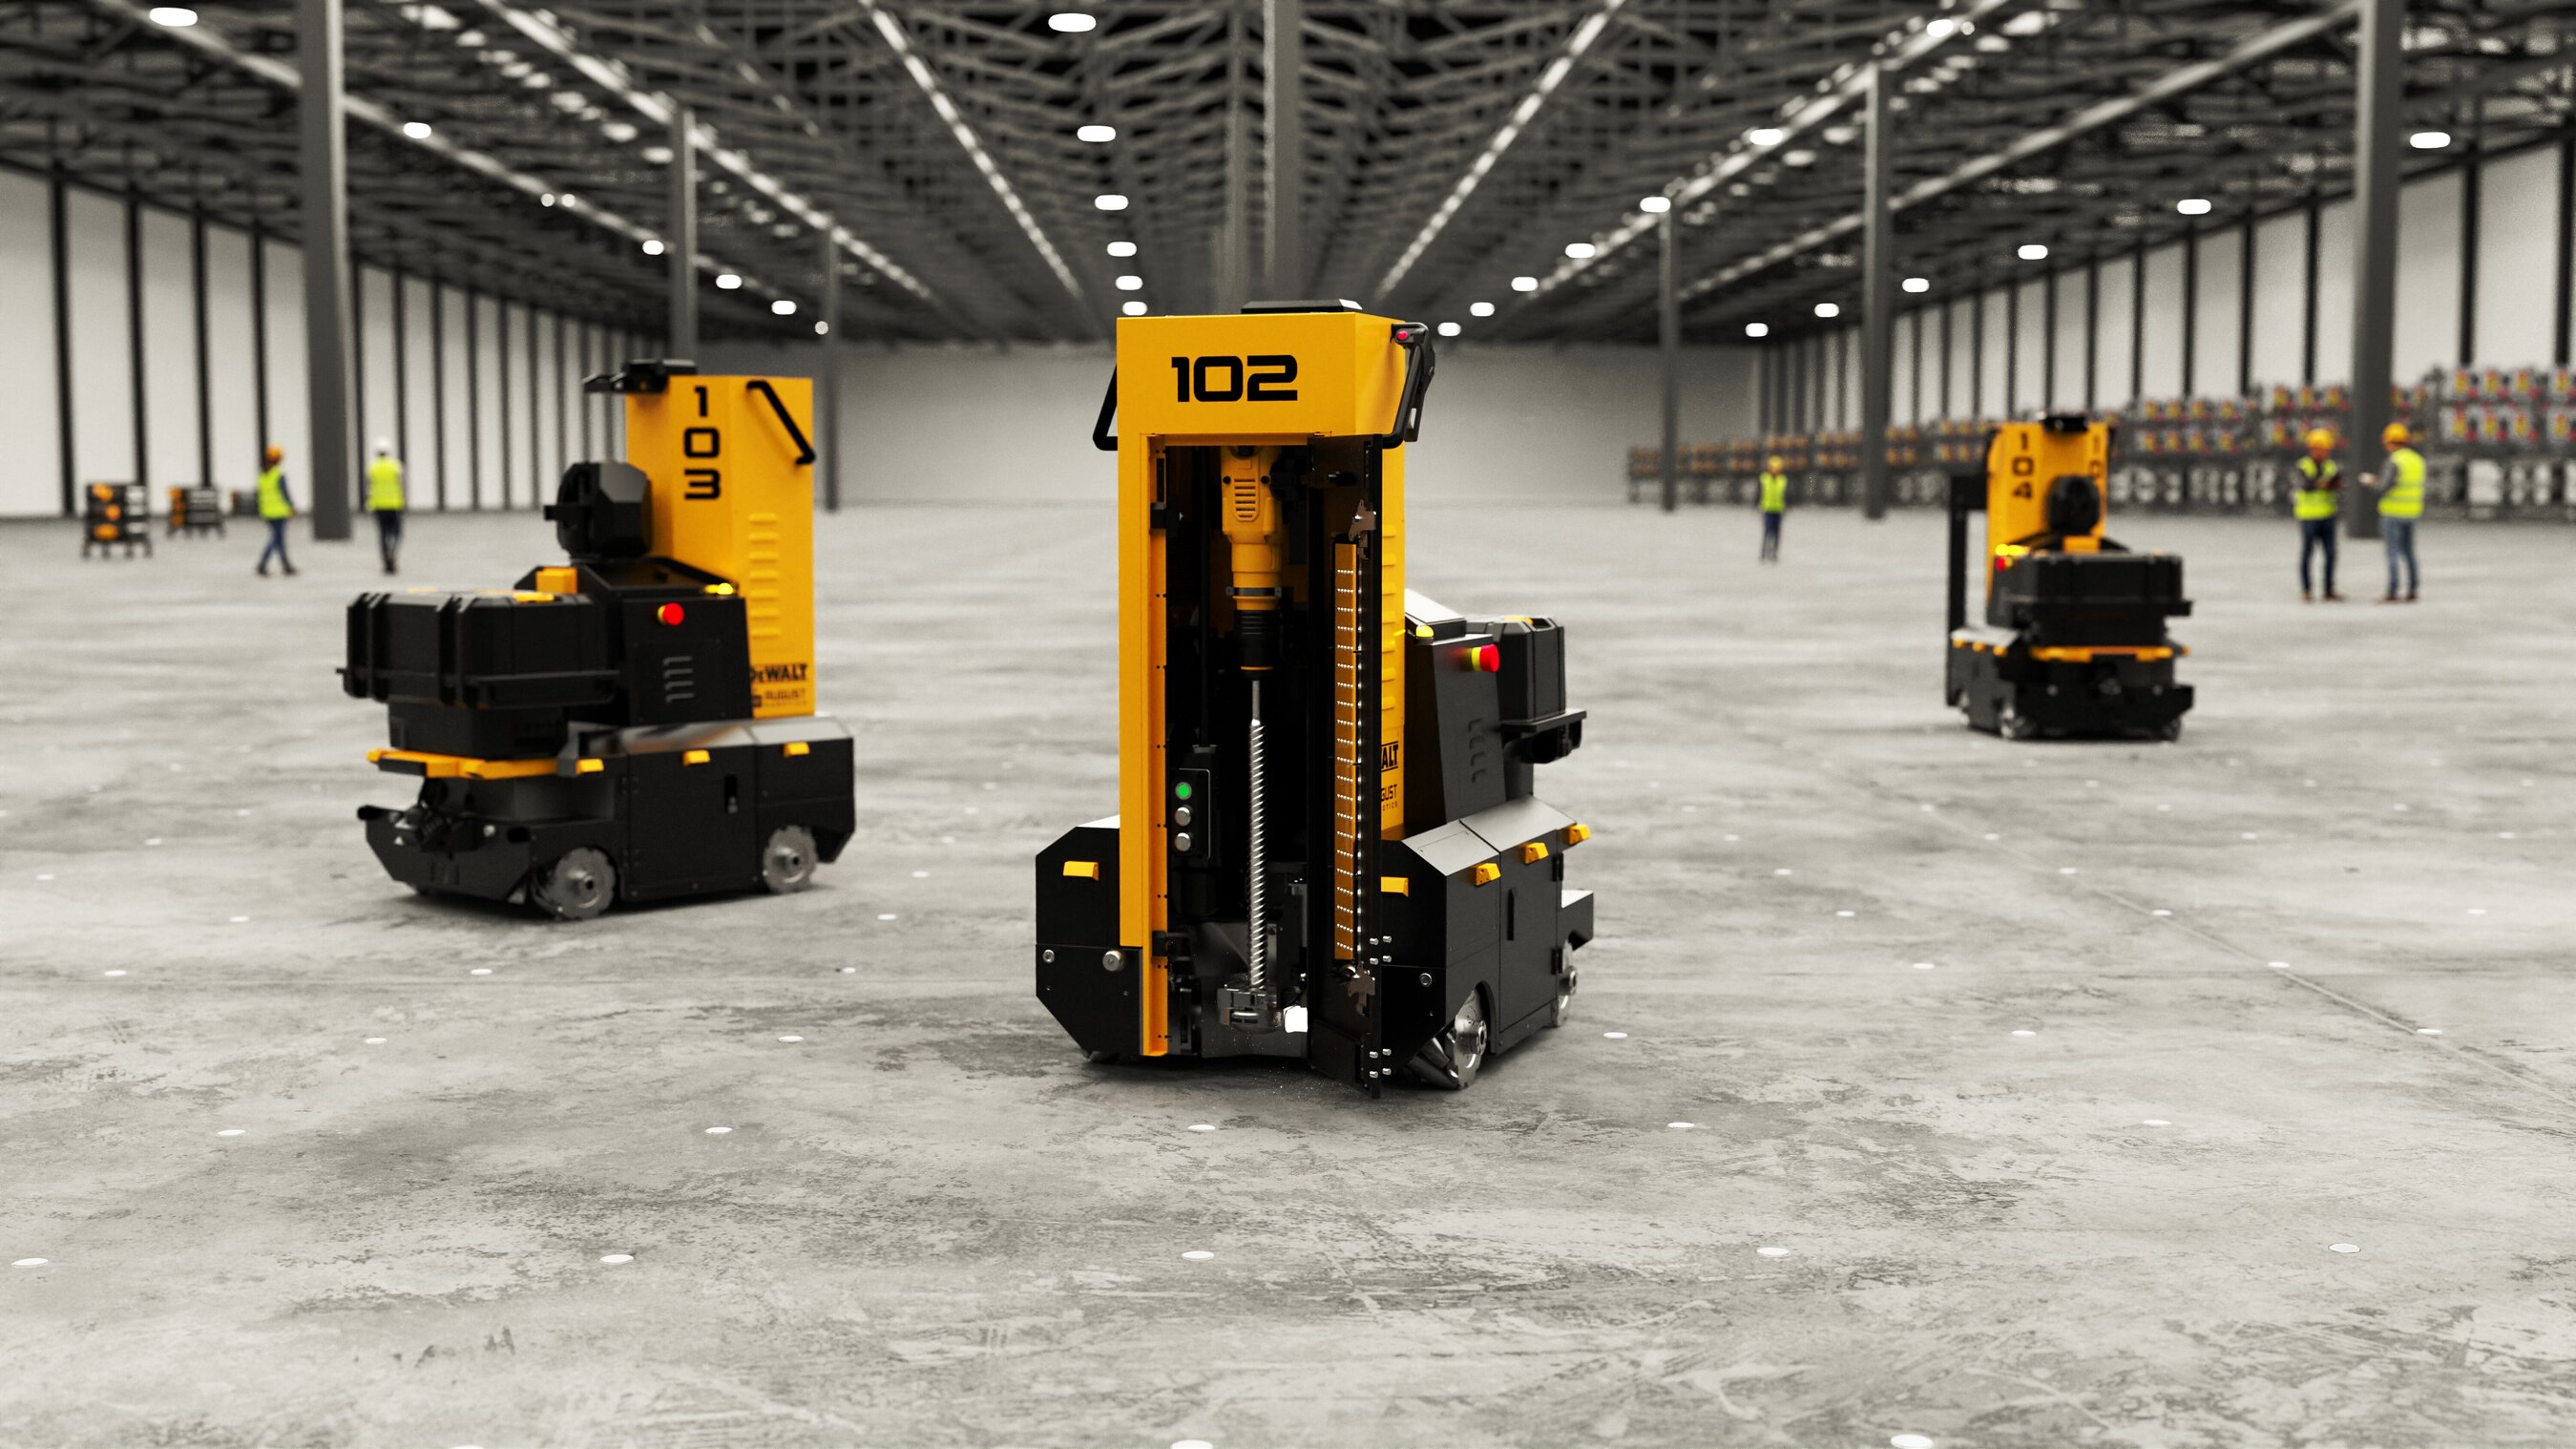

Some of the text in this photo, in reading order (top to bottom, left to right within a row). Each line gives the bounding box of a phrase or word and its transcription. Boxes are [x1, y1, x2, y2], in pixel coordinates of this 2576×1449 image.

[1172, 354, 1298, 402] 102
[684, 386, 720, 499] 103
[2012, 431, 2034, 498] 104
[1381, 744, 1398, 769] ALT
[1381, 784, 1397, 802] GUST
